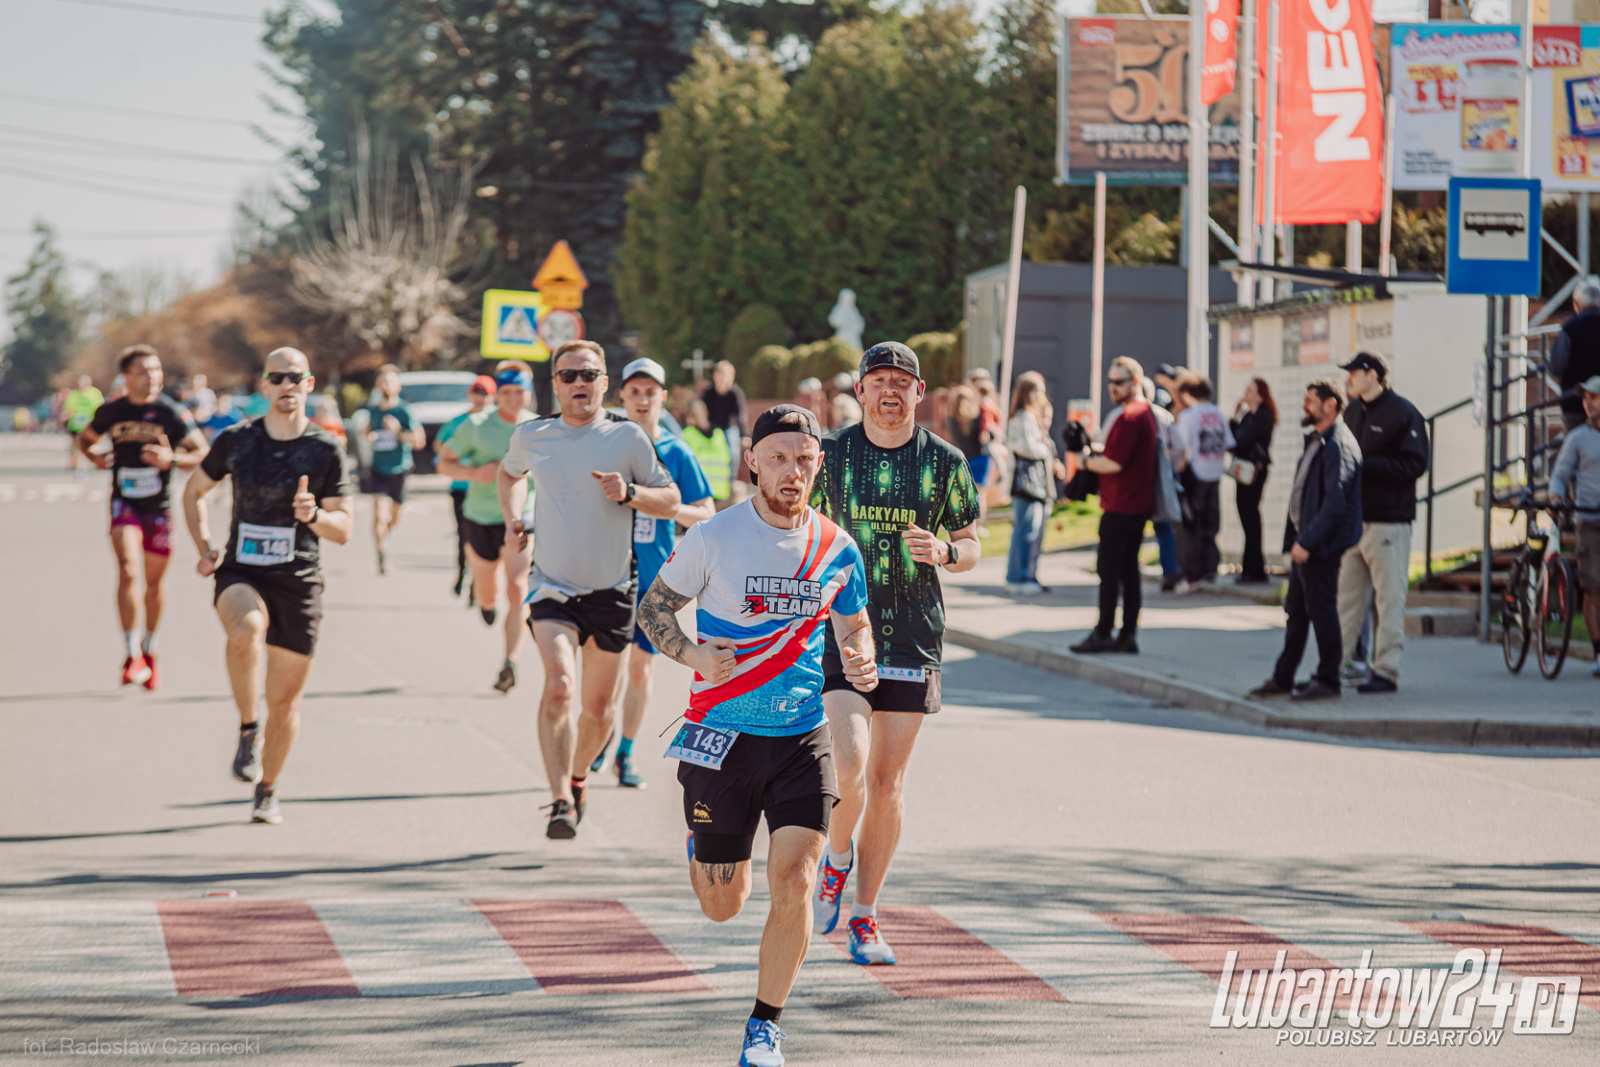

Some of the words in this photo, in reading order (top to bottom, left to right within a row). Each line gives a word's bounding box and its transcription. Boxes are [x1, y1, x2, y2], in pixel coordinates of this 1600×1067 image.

[851, 505, 917, 524] BACKYARD
[871, 521, 897, 532] ULTRA
[878, 538, 890, 585] ONE
[745, 576, 822, 598] NIEMCE
[763, 596, 822, 617] TEAM
[881, 607, 894, 666] MORE
[693, 728, 725, 755] 143
